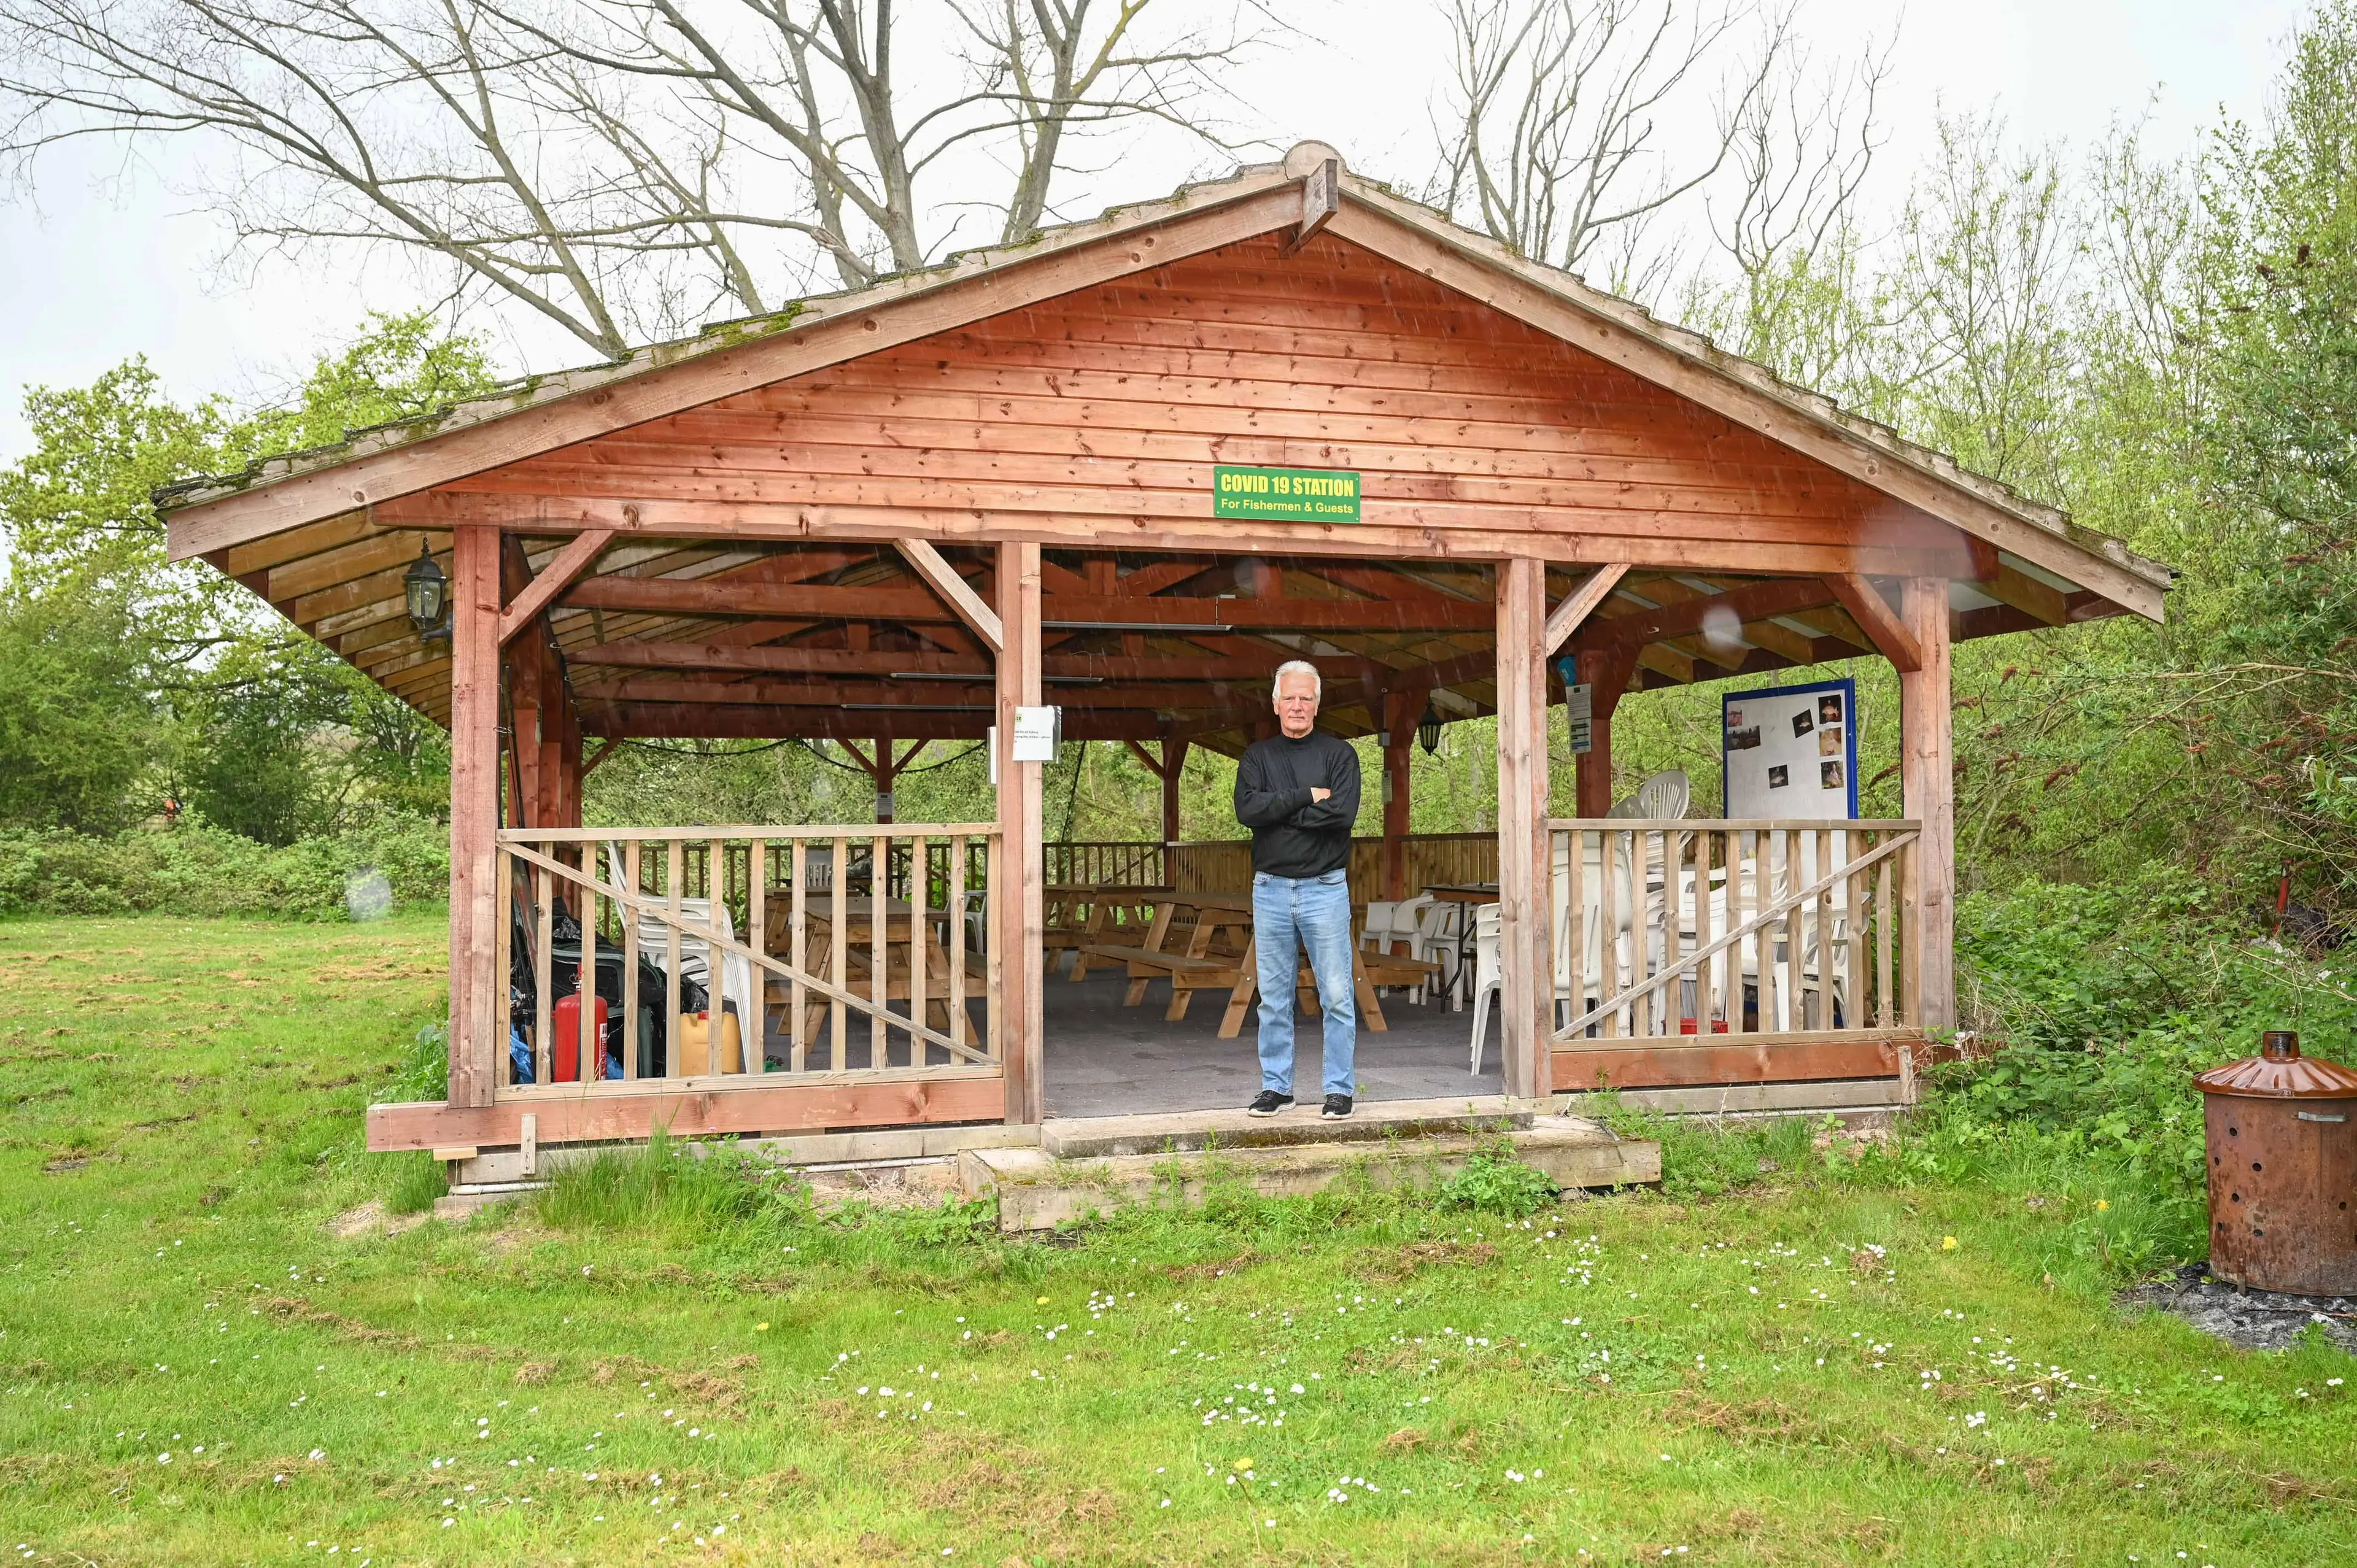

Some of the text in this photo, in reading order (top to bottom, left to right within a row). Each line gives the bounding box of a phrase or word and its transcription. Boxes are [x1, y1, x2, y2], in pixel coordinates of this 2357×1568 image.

[1221, 474, 1353, 496] COVID 19 STATION
[1221, 498, 1353, 513] For Fishermen & Guests
